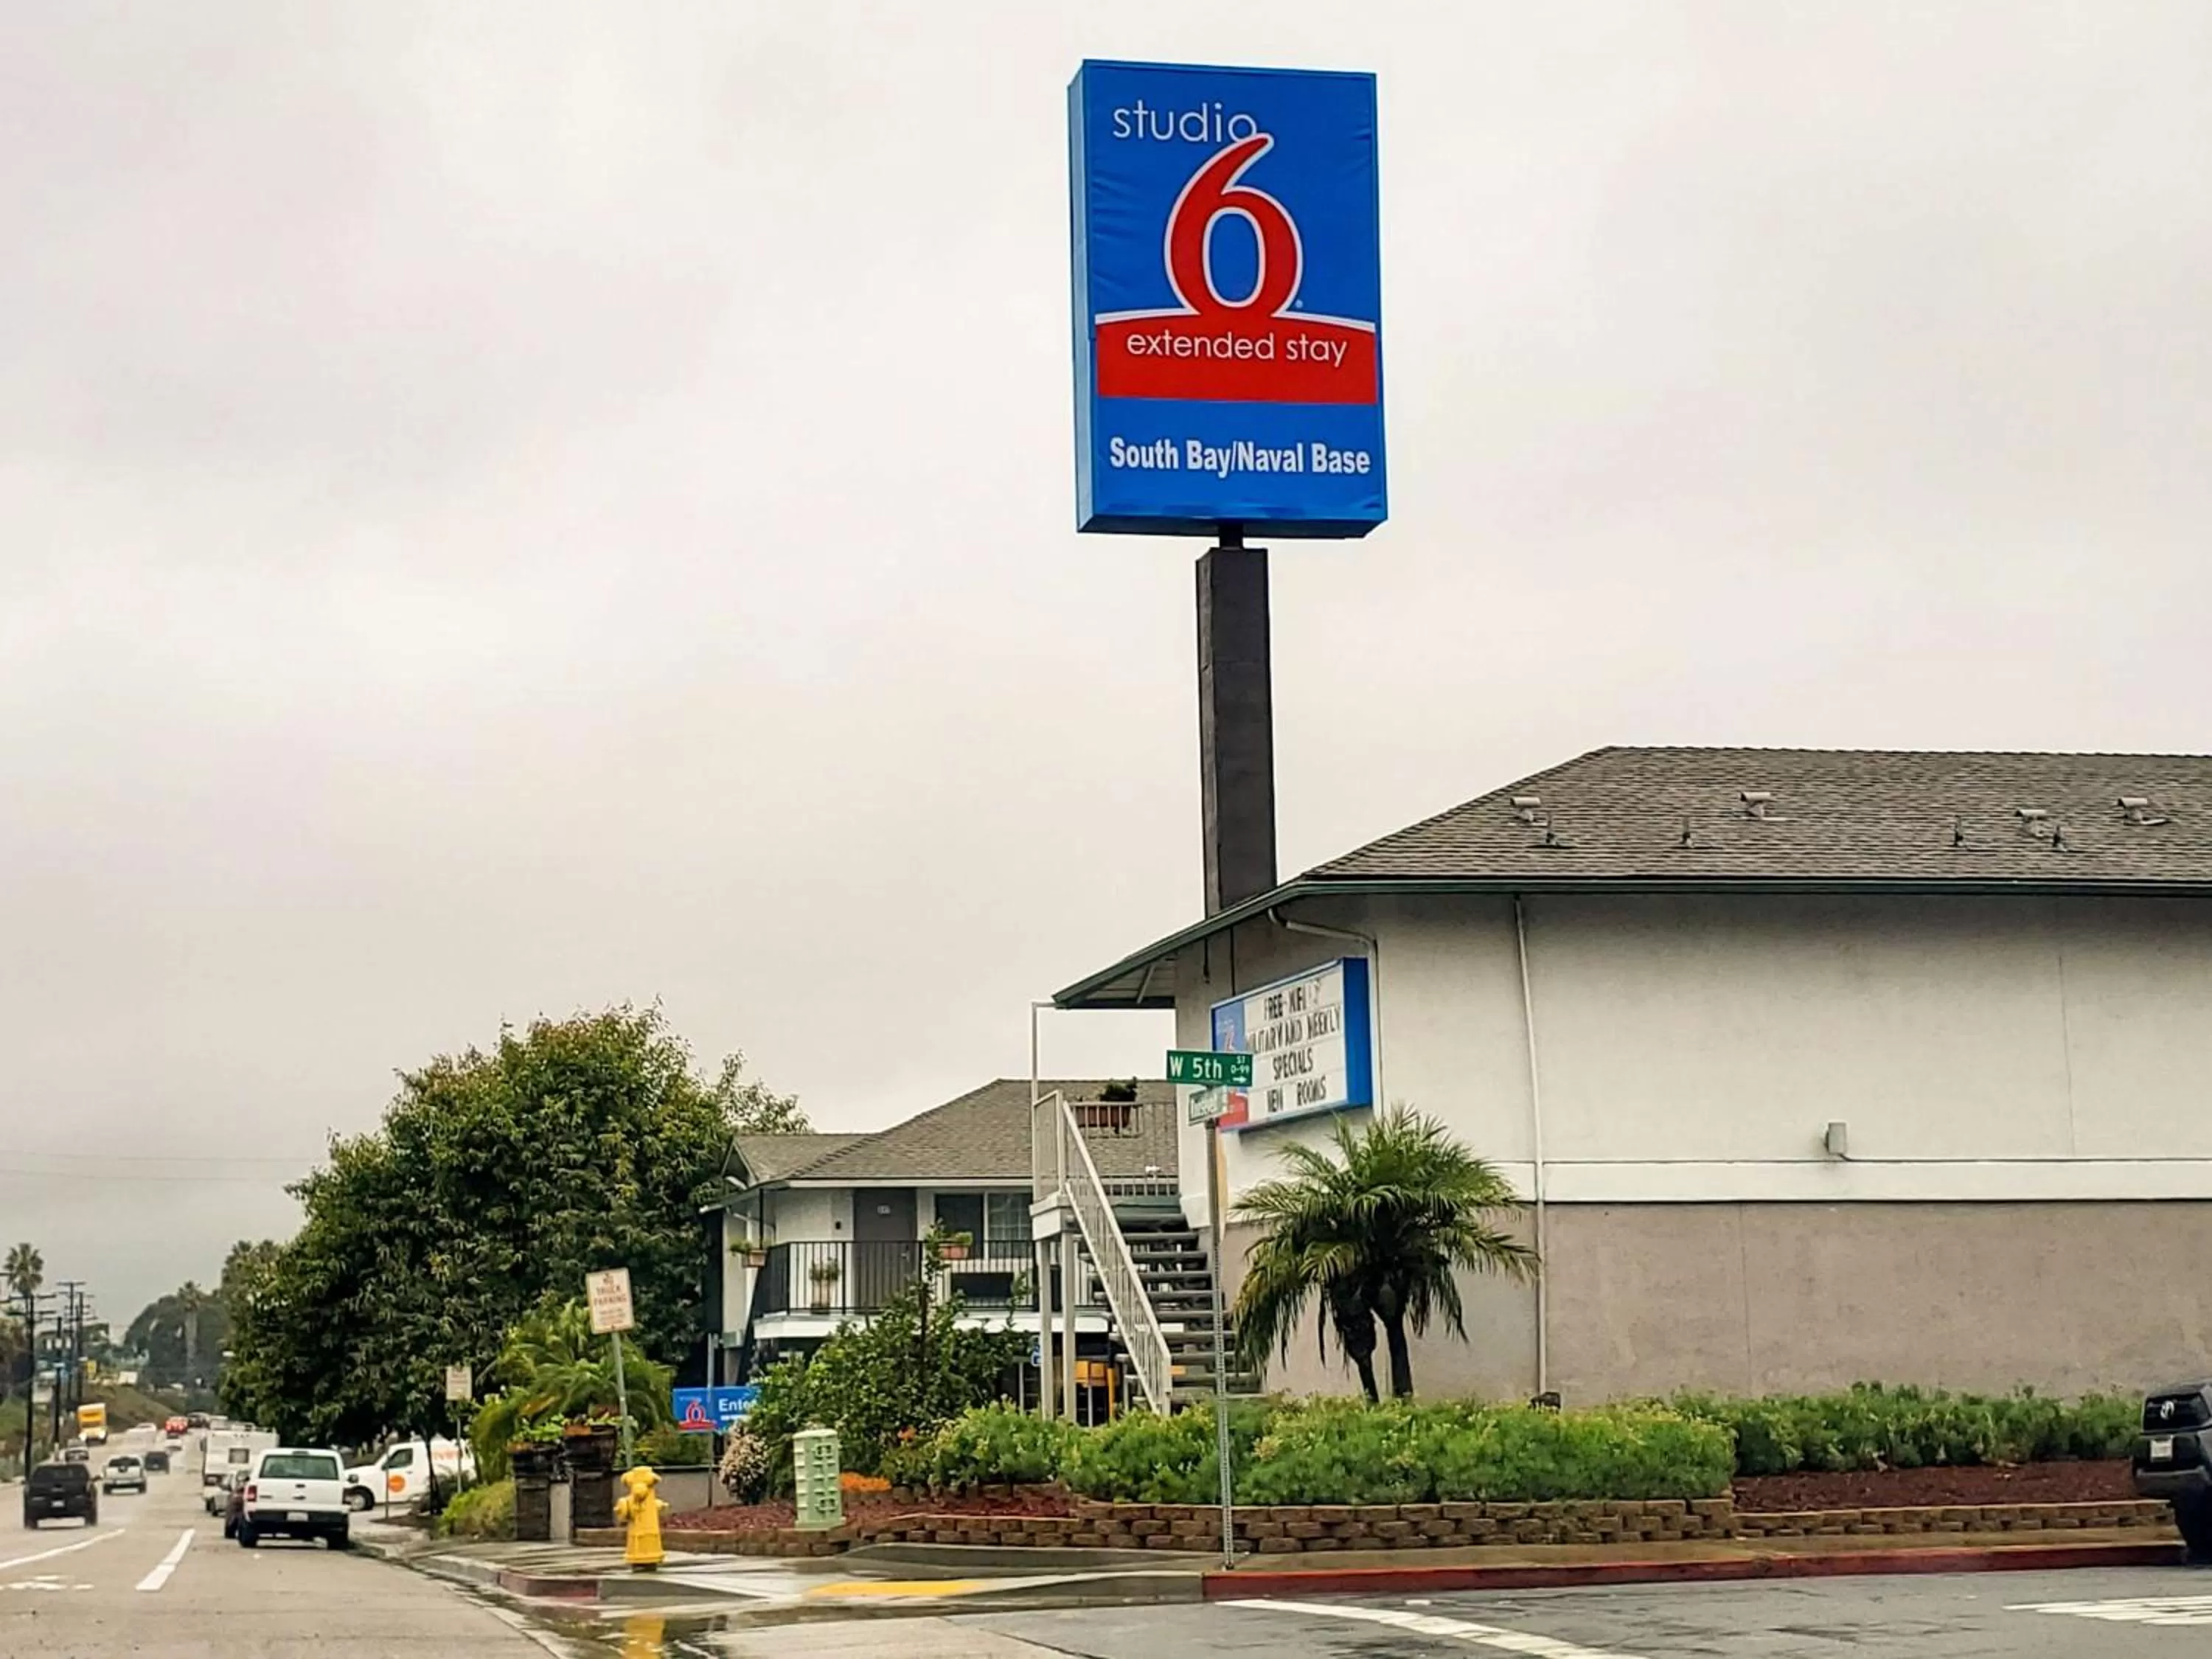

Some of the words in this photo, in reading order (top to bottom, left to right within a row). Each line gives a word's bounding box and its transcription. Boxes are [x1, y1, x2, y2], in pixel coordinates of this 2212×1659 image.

[1113, 100, 1257, 142] studio
[1165, 133, 1303, 316] 6
[1127, 330, 1274, 360] extended
[1286, 333, 1348, 367] stay
[1110, 437, 1179, 471] South
[1186, 440, 1304, 478] Bay/Naval
[1312, 444, 1371, 474] Base
[1169, 1055, 1183, 1077] W
[1192, 1057, 1222, 1079] 5th
[1273, 1047, 1313, 1081] SPECIALS
[1297, 1074, 1326, 1107] ROOMS
